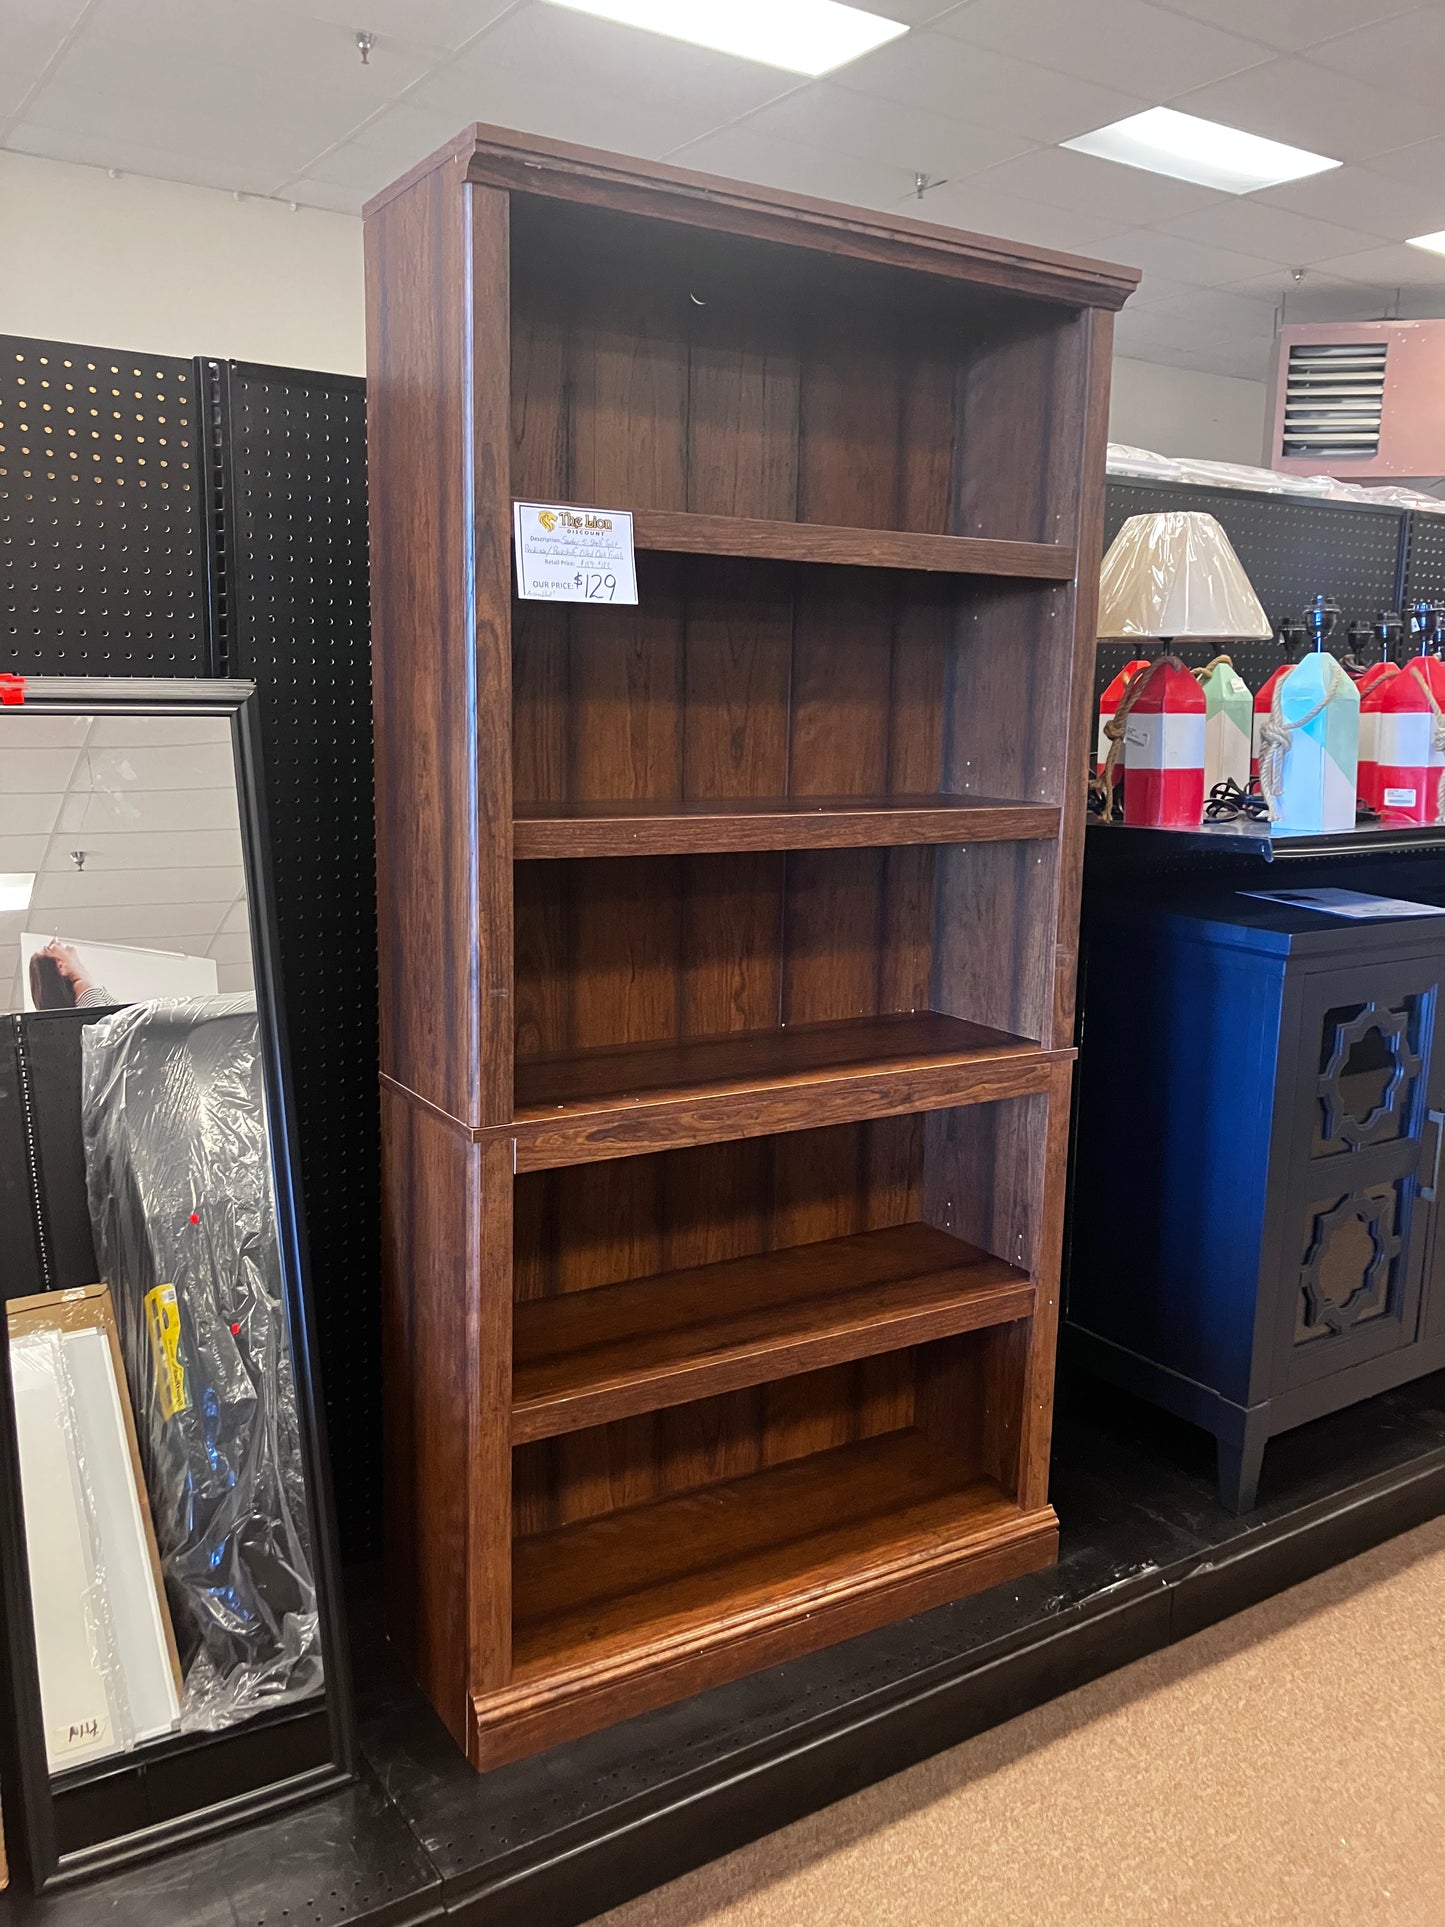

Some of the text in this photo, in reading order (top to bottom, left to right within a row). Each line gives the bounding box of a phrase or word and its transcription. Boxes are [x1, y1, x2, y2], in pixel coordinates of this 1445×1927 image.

[559, 512, 612, 530] The Lion
[532, 572, 616, 601] OUR PRICE: $129
